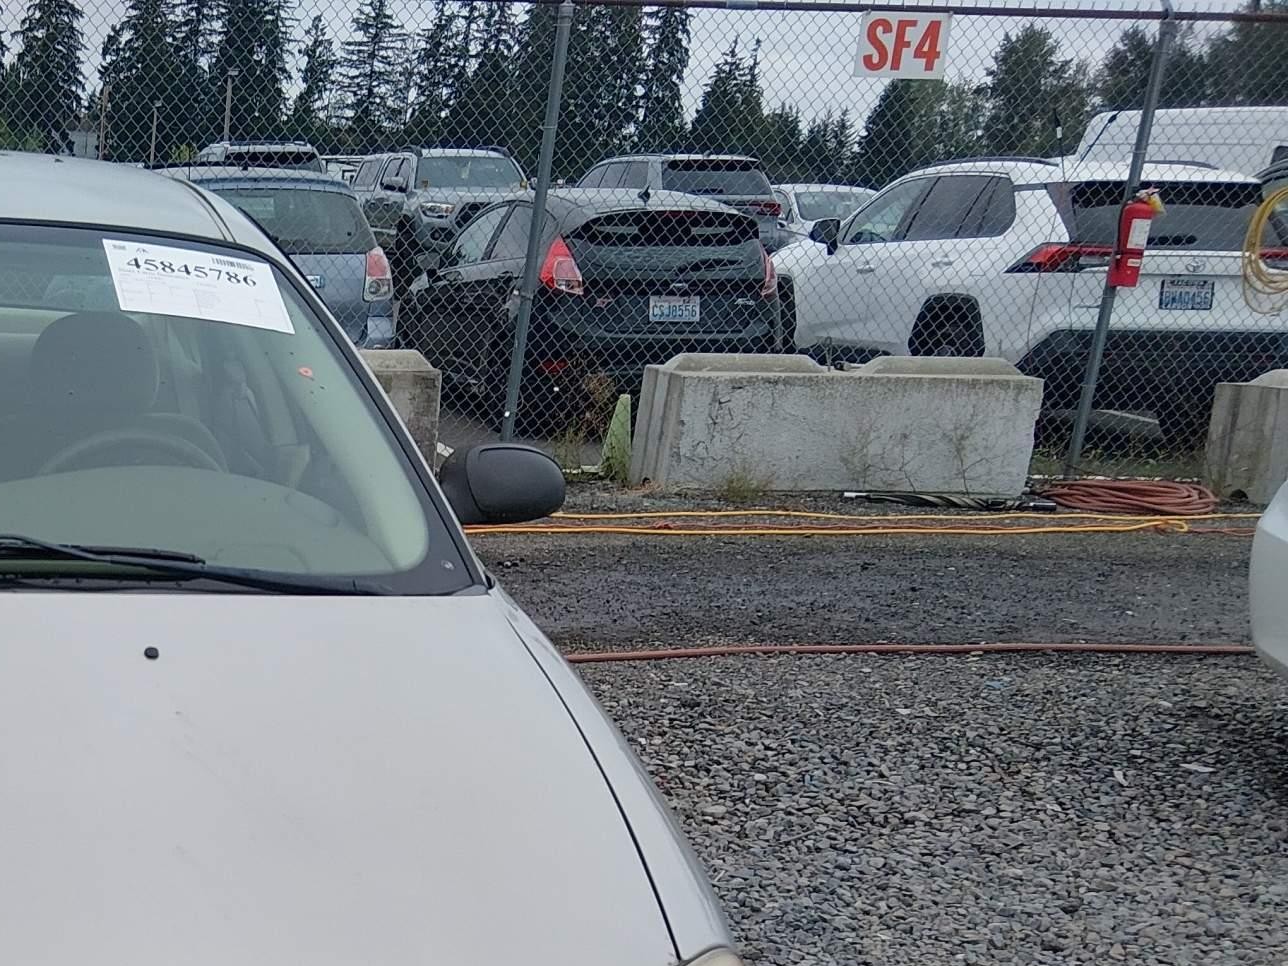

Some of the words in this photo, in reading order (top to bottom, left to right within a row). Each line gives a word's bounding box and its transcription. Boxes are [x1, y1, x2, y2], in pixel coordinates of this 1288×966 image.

[862, 18, 942, 71] SF4
[126, 257, 257, 288] 45845786
[651, 304, 697, 318] CSJ8556
